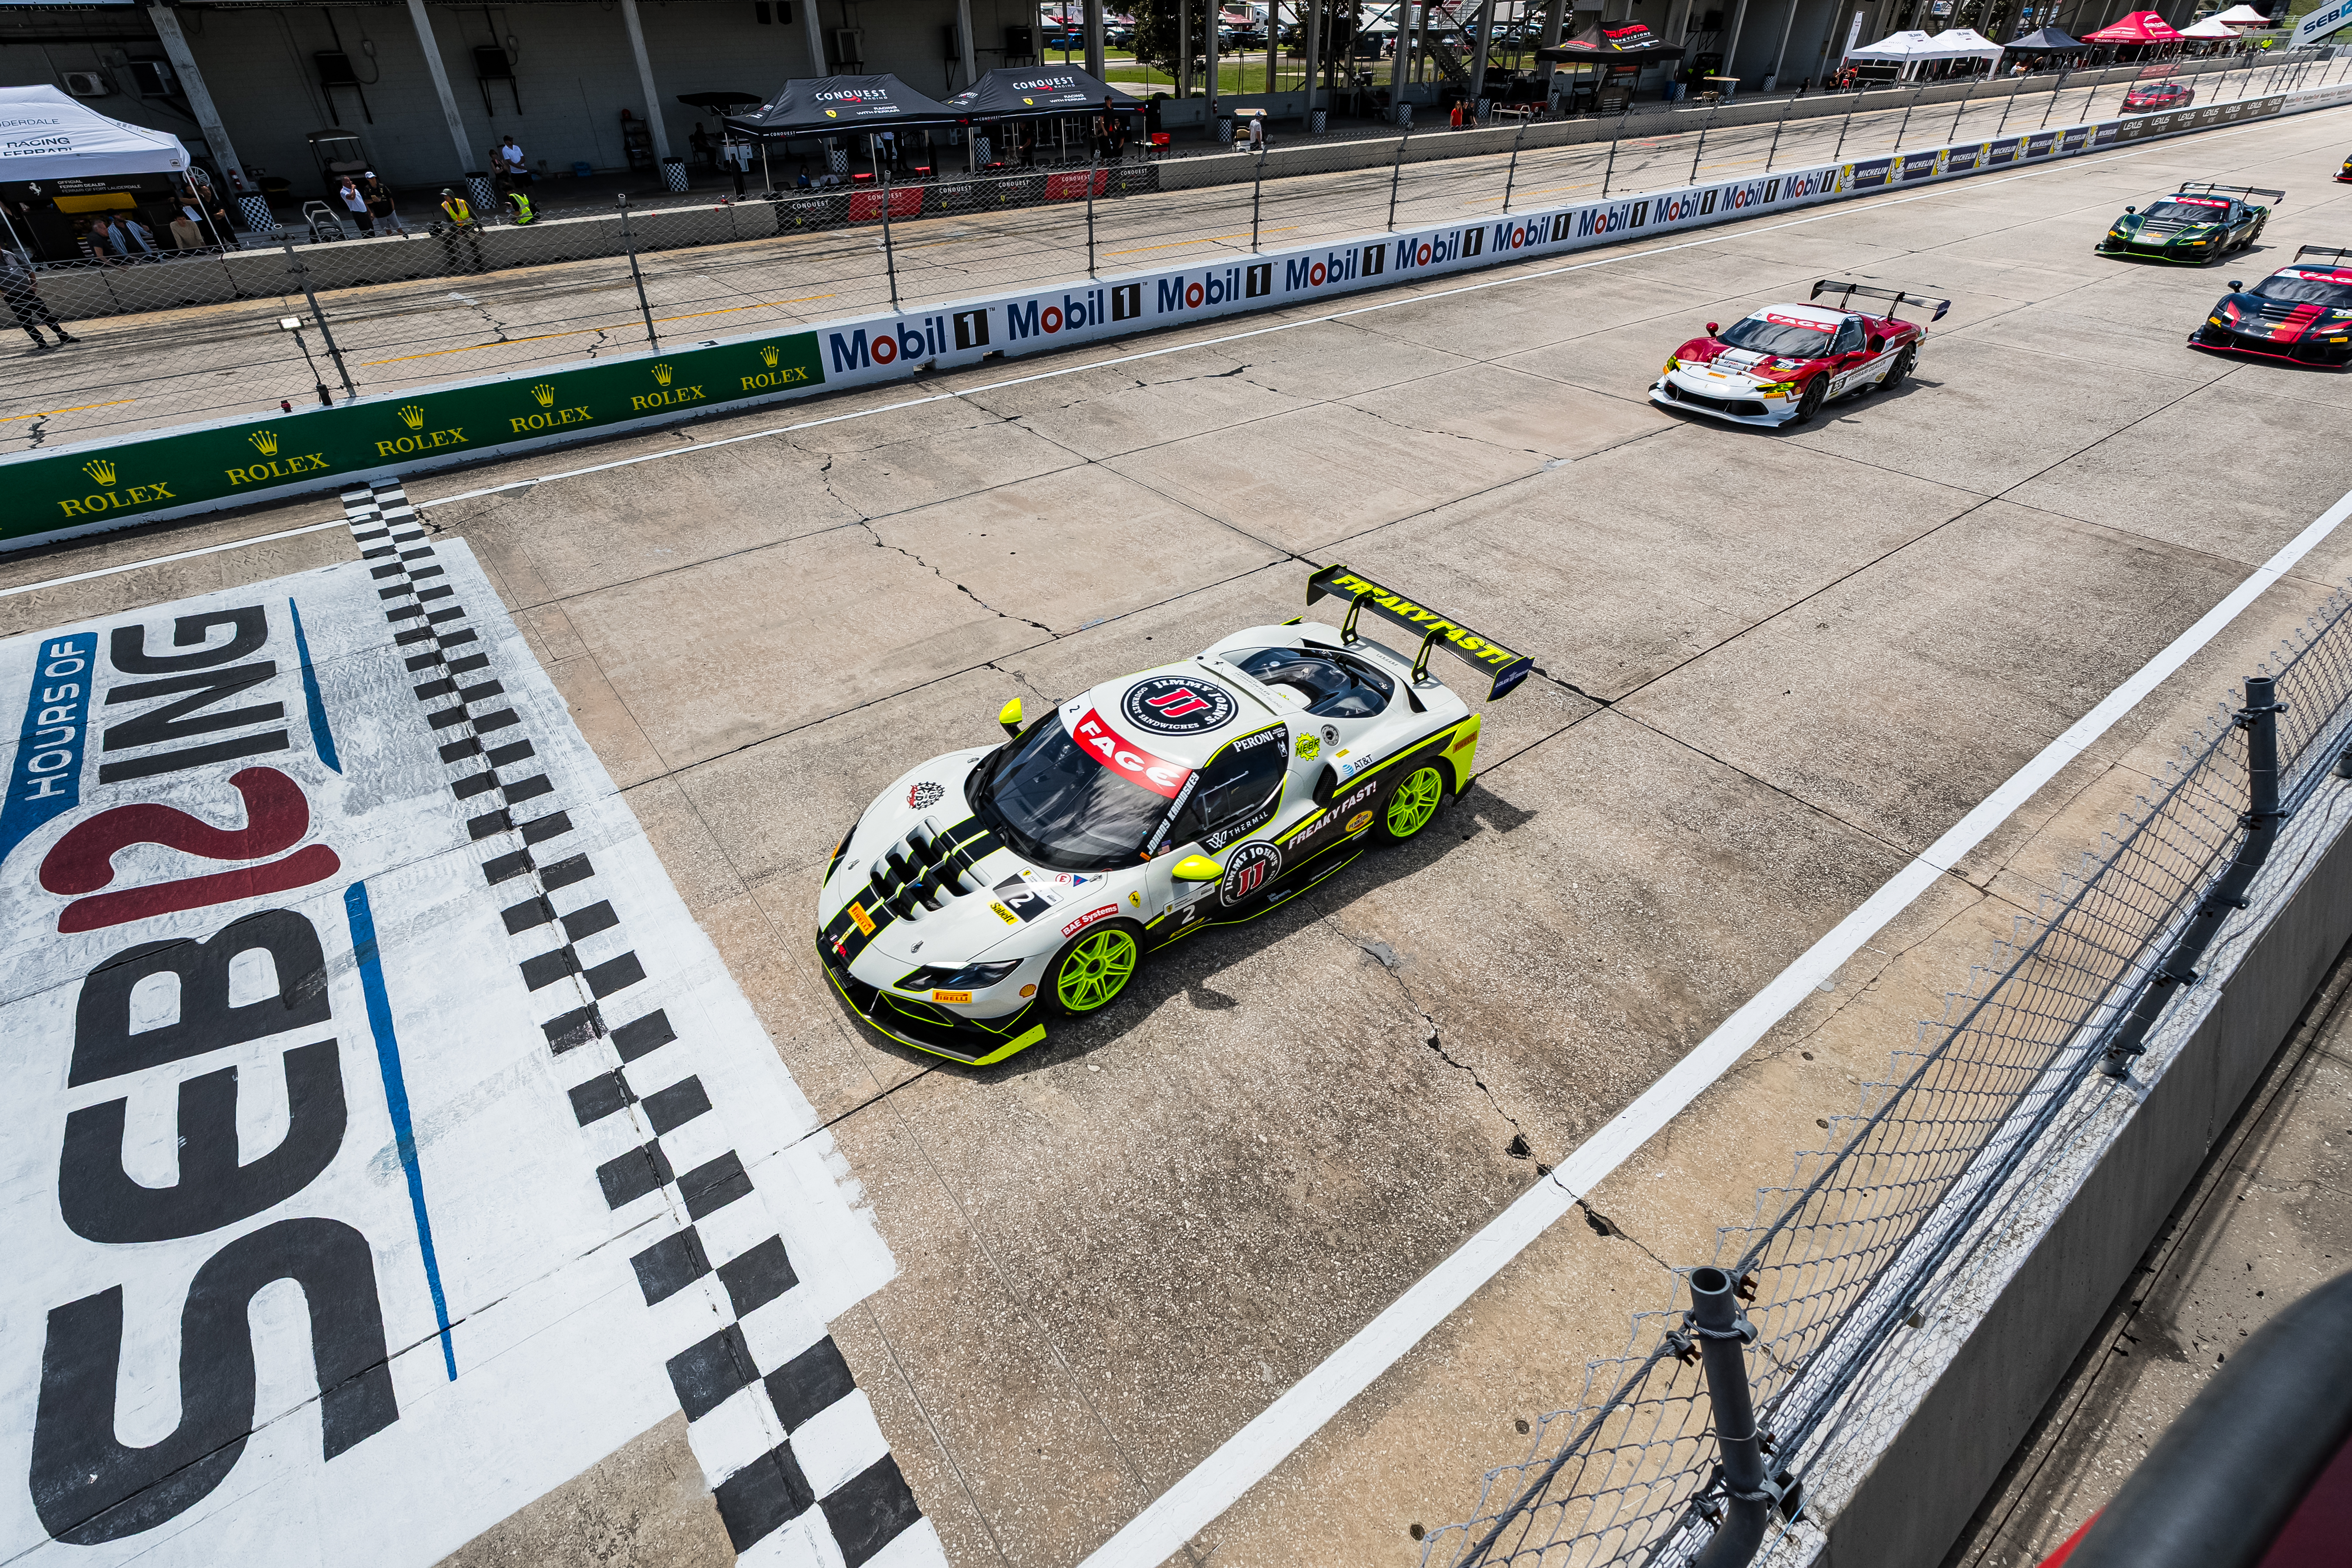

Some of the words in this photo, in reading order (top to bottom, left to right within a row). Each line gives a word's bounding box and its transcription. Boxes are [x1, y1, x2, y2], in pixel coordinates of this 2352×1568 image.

[1609, 32, 1650, 43] COMPETIZIONE
[1012, 77, 1074, 90] CONQUEST
[816, 89, 886, 101] CONQUEST
[2268, 98, 2283, 106] LEXUS
[2203, 108, 2220, 117] LEXUS
[2225, 105, 2242, 114] LEXUS
[2247, 101, 2264, 110] LEXUS
[0, 119, 60, 127] DERDALE
[2123, 120, 2143, 130] LEXUS
[2151, 116, 2171, 126] LEXUS
[2178, 111, 2197, 121] LEXUS
[2065, 134, 2086, 142] MICHELIN
[2098, 128, 2118, 136] MICHELIN
[7, 137, 70, 148] RACING
[1991, 145, 2017, 155] MICHELIN
[2030, 139, 2053, 148] MICHELIN
[1906, 158, 1935, 170] MICHELIN
[1951, 152, 1978, 162] MICHELIN
[1857, 166, 1889, 178] MICHELIN
[1782, 171, 1823, 200] Mobil
[1825, 170, 1832, 191] 1
[793, 200, 829, 209] CONQUEST
[1720, 181, 1765, 212] Mobil
[1769, 180, 1776, 202] 1
[1653, 192, 1701, 224] Mobil
[1706, 191, 1713, 213] 1
[1577, 203, 1630, 237] Mobil
[1636, 203, 1643, 226] 1
[1492, 216, 1551, 253] Mobil
[1558, 215, 1565, 239] 1
[1395, 231, 1461, 270] Mobil
[1469, 230, 1477, 254] 1
[1286, 248, 1359, 292] Mobil
[1369, 247, 1377, 274] 1
[2303, 273, 2352, 283] FAG
[1158, 267, 1240, 314] Mobil
[1254, 266, 1262, 295] 1
[1007, 289, 1104, 341] Mobil
[1120, 287, 1130, 317] 1
[829, 315, 947, 373] Mobil
[963, 314, 977, 345] 1
[740, 367, 809, 390] ROLEX
[1845, 377, 1865, 388] FERRARI
[1870, 364, 1890, 376] SEATTLE
[1849, 369, 1868, 381] FERRARI
[1869, 360, 1886, 371] DEALER
[1833, 379, 1843, 391] 55
[631, 385, 707, 411] ROLEX
[509, 406, 594, 433] ROLEX
[375, 427, 469, 457] ROLEX
[224, 452, 330, 486] ROLEX
[57, 482, 176, 517] ROLEX
[1332, 574, 1438, 622] FREAKY
[1425, 620, 1512, 664] FAST!
[44, 641, 85, 678] OF
[1238, 671, 1258, 684] OFFICIAL
[1495, 678, 1509, 688] ADLER
[1253, 684, 1270, 695] DEALER
[1254, 688, 1267, 697] LONG
[1266, 696, 1282, 708] ISLAND
[1069, 705, 1080, 713] 2
[1132, 687, 1148, 714] GOURMET
[1144, 687, 1212, 718] JJ
[1153, 679, 1213, 691] JIMMY
[1204, 693, 1228, 725] JOHN'S
[1138, 714, 1199, 729] SANDWICHES
[24, 683, 80, 801] HOURS
[1232, 731, 1275, 752] PERONI
[1296, 737, 1320, 756] NEBR
[1354, 754, 1373, 770] AT&T
[1148, 818, 1171, 855] JOHNNY
[1167, 772, 1199, 821] KAMINSKEY
[1288, 805, 1341, 850] FREAKY
[1342, 781, 1377, 813] FAST!
[1349, 813, 1369, 830] PENNZOIL
[1228, 811, 1269, 837] THERMAL
[1225, 852, 1248, 891] JIMMY
[1250, 847, 1278, 867] JOHN'S
[1237, 859, 1266, 897] JJ
[1009, 889, 1035, 909] 2
[851, 906, 872, 931] PIRELLI
[990, 902, 1016, 923] Sabelt
[1063, 921, 1082, 934] BAE
[1082, 905, 1117, 922] Systems
[1181, 905, 1195, 924] 2
[935, 991, 969, 1001] PIRELLI
